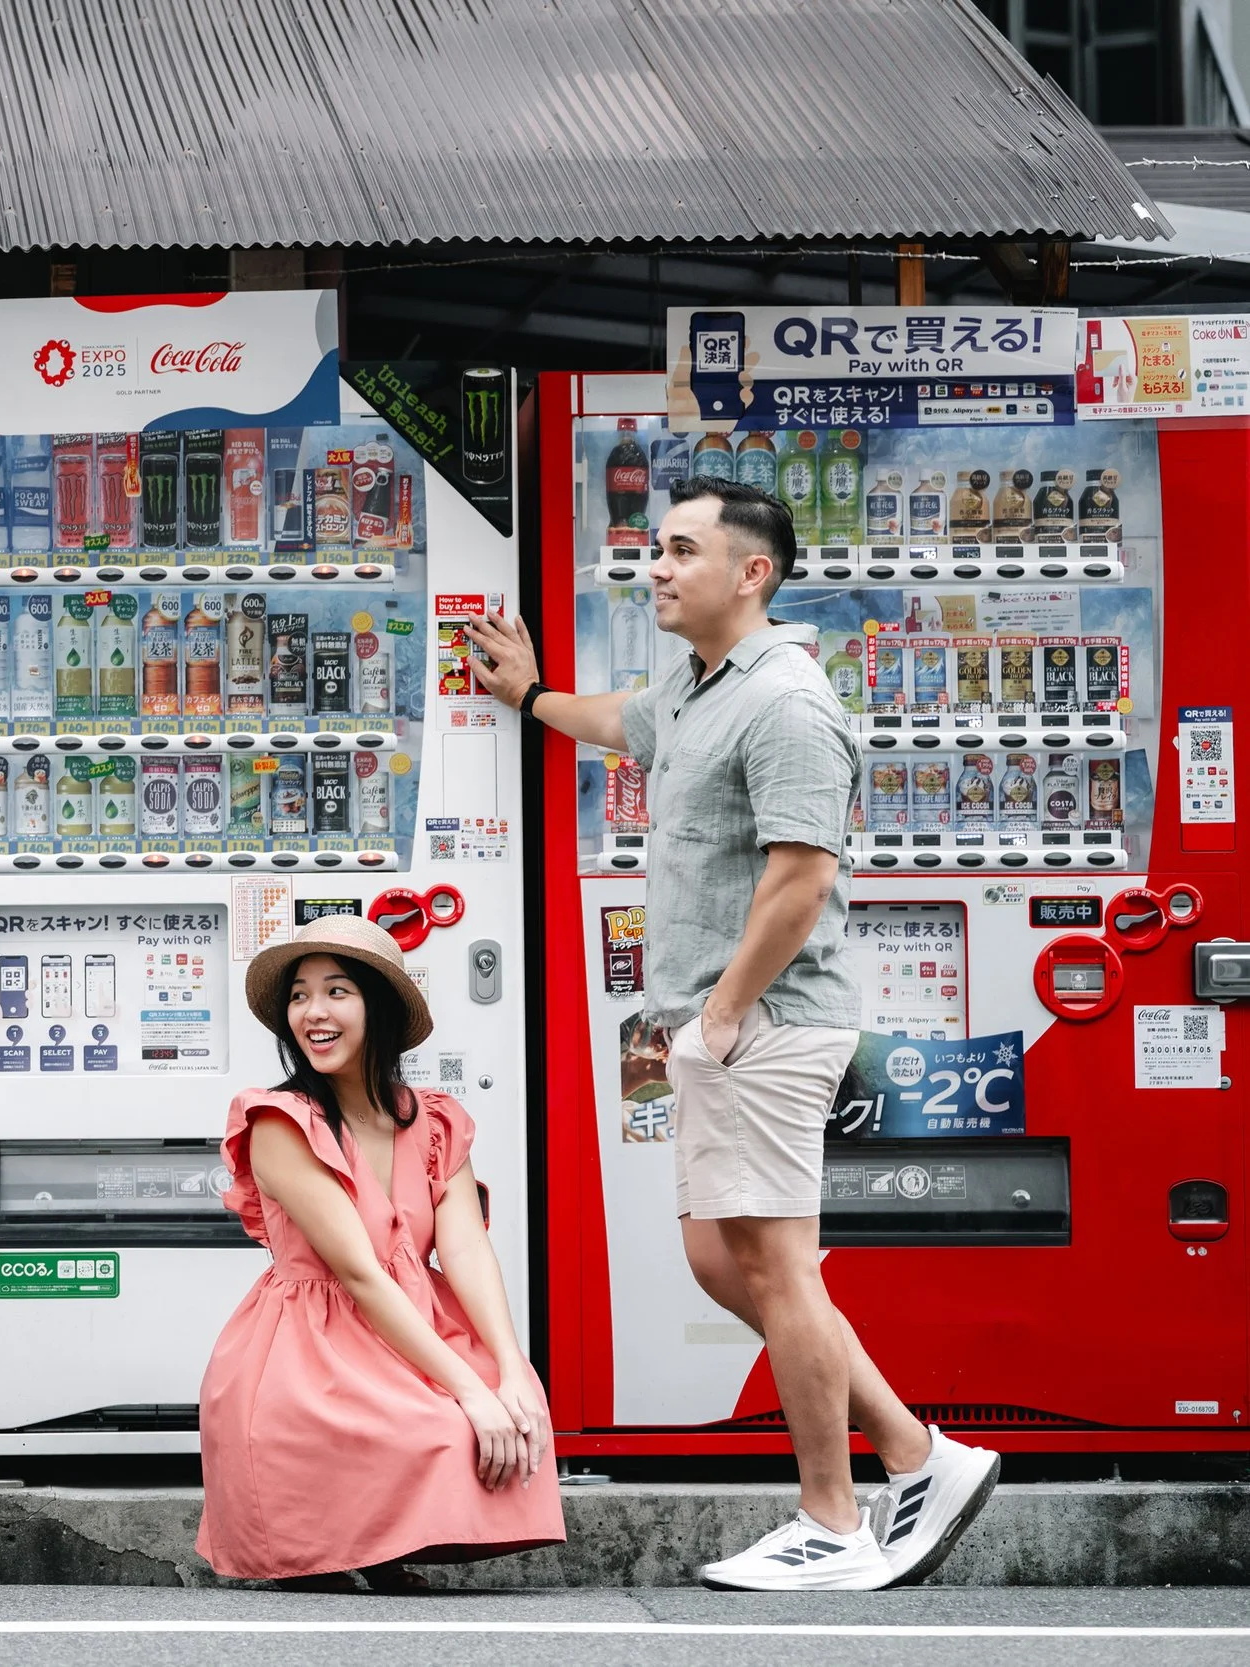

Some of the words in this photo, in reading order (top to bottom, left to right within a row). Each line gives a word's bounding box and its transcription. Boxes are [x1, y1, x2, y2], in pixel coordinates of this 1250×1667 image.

[773, 316, 1043, 358] QRで買える!
[1193, 330, 1216, 339] Coke
[704, 338, 729, 351] QR
[82, 350, 126, 362] EXPO
[705, 352, 731, 364] 決済
[1142, 355, 1175, 366] たまる!
[82, 364, 126, 377] 2025
[849, 360, 882, 375] Pay
[888, 359, 929, 373] with
[936, 358, 963, 372] QR
[1143, 382, 1184, 394] もらえる!
[378, 364, 447, 435] Unleash
[773, 386, 903, 404] QRをスキャン!
[354, 368, 385, 404] the
[386, 401, 454, 461] Beast!
[775, 407, 890, 425] すぐに使える!
[464, 451, 504, 463] MONSTER
[652, 458, 688, 469] AQUARIUS
[14, 492, 49, 500] POCARI
[15, 500, 46, 508] SWEAT
[462, 602, 482, 610] drink
[149, 643, 172, 656] 麦茶
[190, 643, 215, 657] 麦茶
[317, 667, 346, 680] BLACK
[959, 667, 988, 675] GOLDEN
[1002, 666, 1031, 674] GOLDEN
[143, 695, 177, 704] カフェイン
[186, 695, 219, 704] カフェイン
[1185, 710, 1226, 718] QRで買える!
[254, 761, 277, 770] 新製品
[150, 783, 171, 792] CALPIS
[192, 782, 214, 791] CALPIS
[316, 786, 346, 800] BLACK
[149, 793, 172, 810] SODA
[192, 792, 215, 809] SODA
[1051, 800, 1074, 809] COSTA
[1077, 885, 1091, 893] Pay
[1040, 905, 1092, 920] 販売中
[117, 914, 219, 931] すぐに使える!
[137, 936, 159, 946] Pay
[163, 935, 191, 945] with
[193, 936, 212, 945] QR
[1144, 1046, 1211, 1054] 9300168705
[892, 1057, 920, 1066] 夏だけ
[935, 1053, 986, 1063] いつもより
[891, 1068, 922, 1077] 冷たい!
[927, 1118, 991, 1129] 自動販売機
